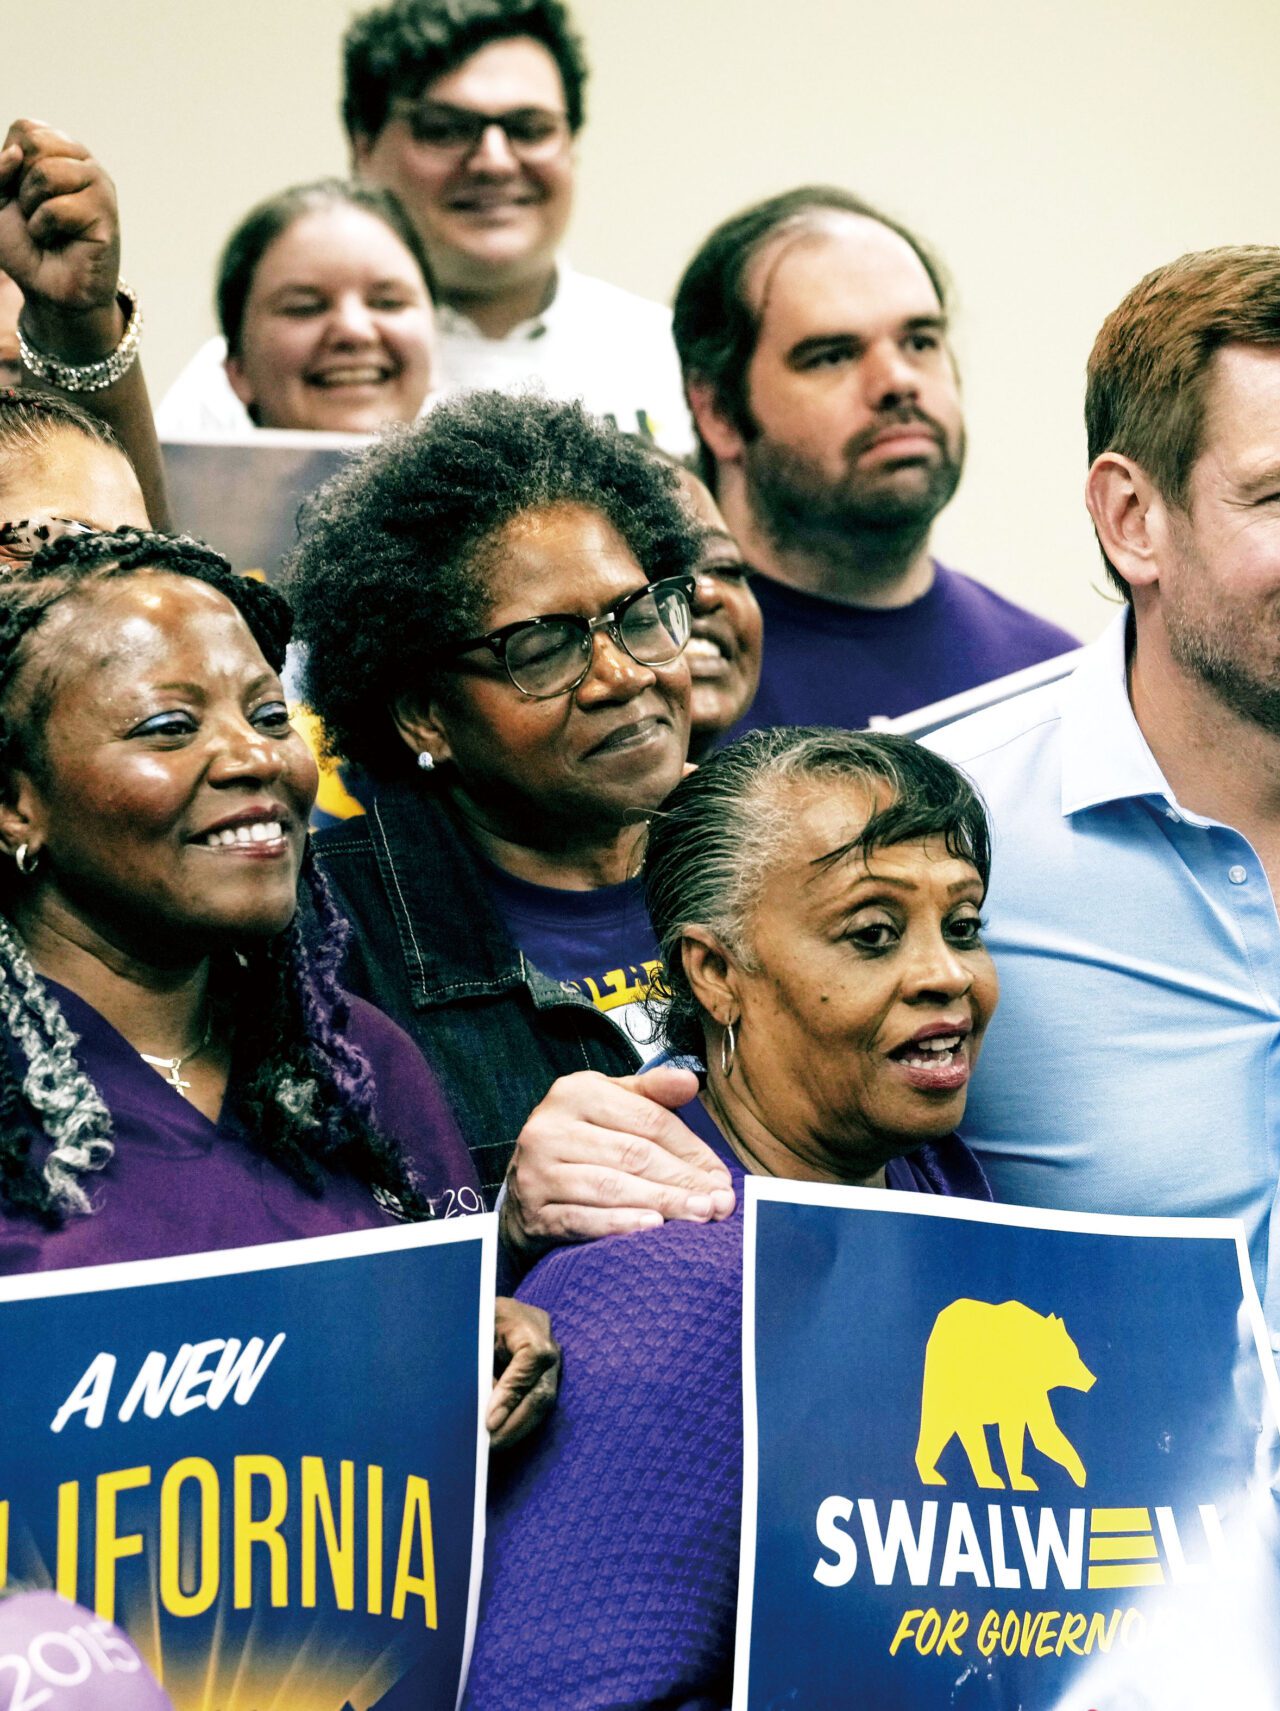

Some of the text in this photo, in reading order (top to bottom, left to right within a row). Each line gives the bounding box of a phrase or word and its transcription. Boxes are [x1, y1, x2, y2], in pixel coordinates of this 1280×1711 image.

[50, 1332, 287, 1433] A NEW
[888, 1606, 1168, 1657] FOR GOVERNO
